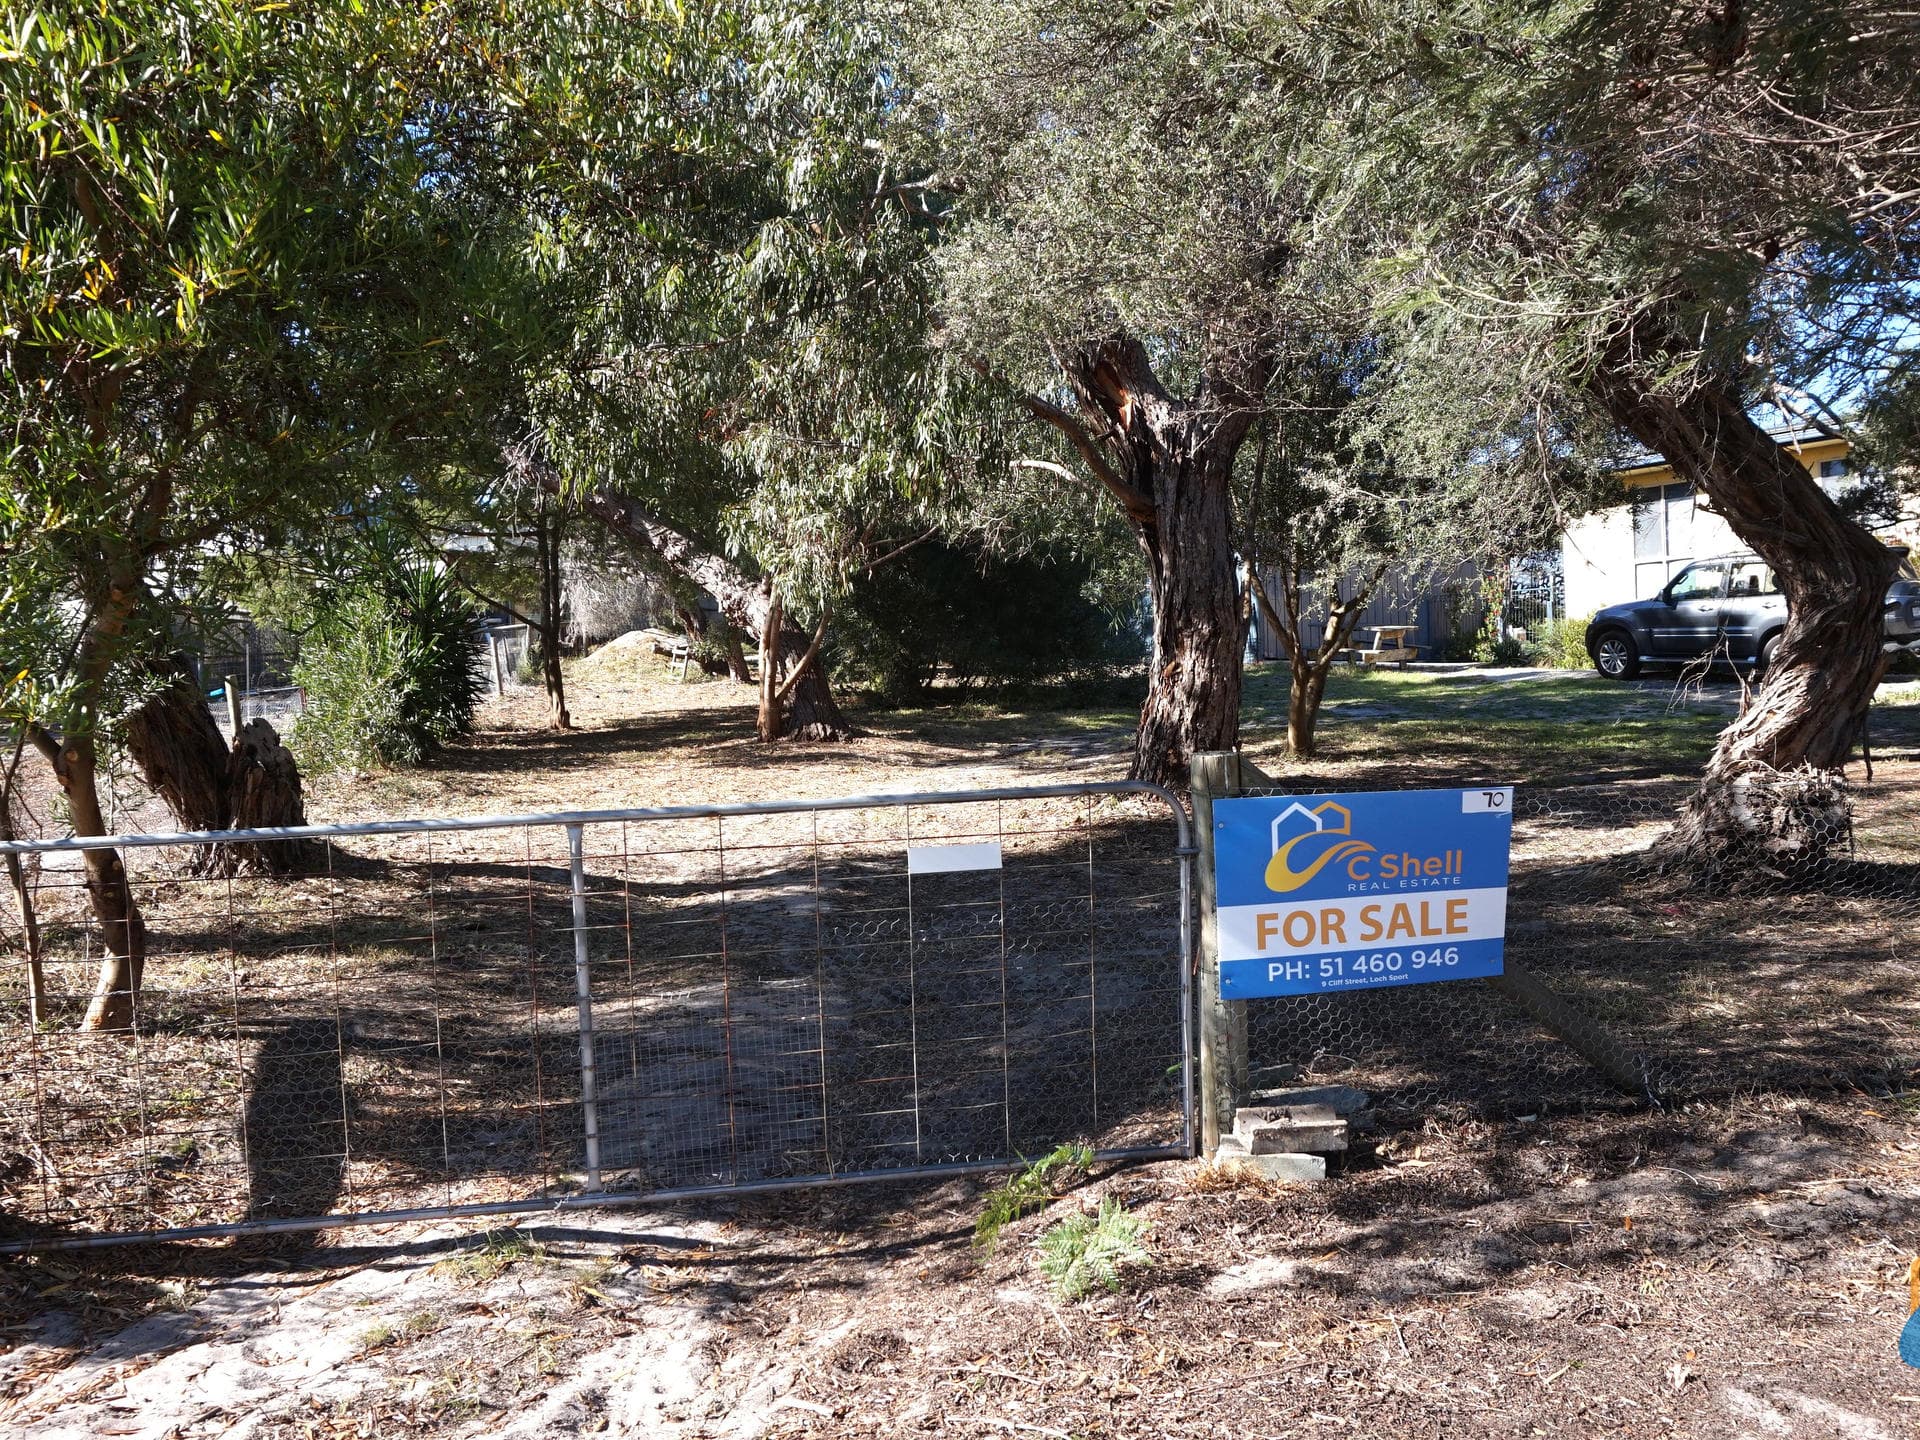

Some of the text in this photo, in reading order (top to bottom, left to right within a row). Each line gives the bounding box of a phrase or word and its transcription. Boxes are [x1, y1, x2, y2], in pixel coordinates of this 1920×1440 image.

[1483, 792, 1504, 808] 70
[1347, 850, 1463, 880] C Shell
[1348, 877, 1461, 891] REAL ESTATE
[1256, 898, 1468, 950] FOR SALE
[1268, 947, 1459, 982] PH: 51 460 946
[1345, 977, 1368, 986] Street,
[1370, 975, 1387, 983] Loch
[1389, 973, 1408, 982] Sport
